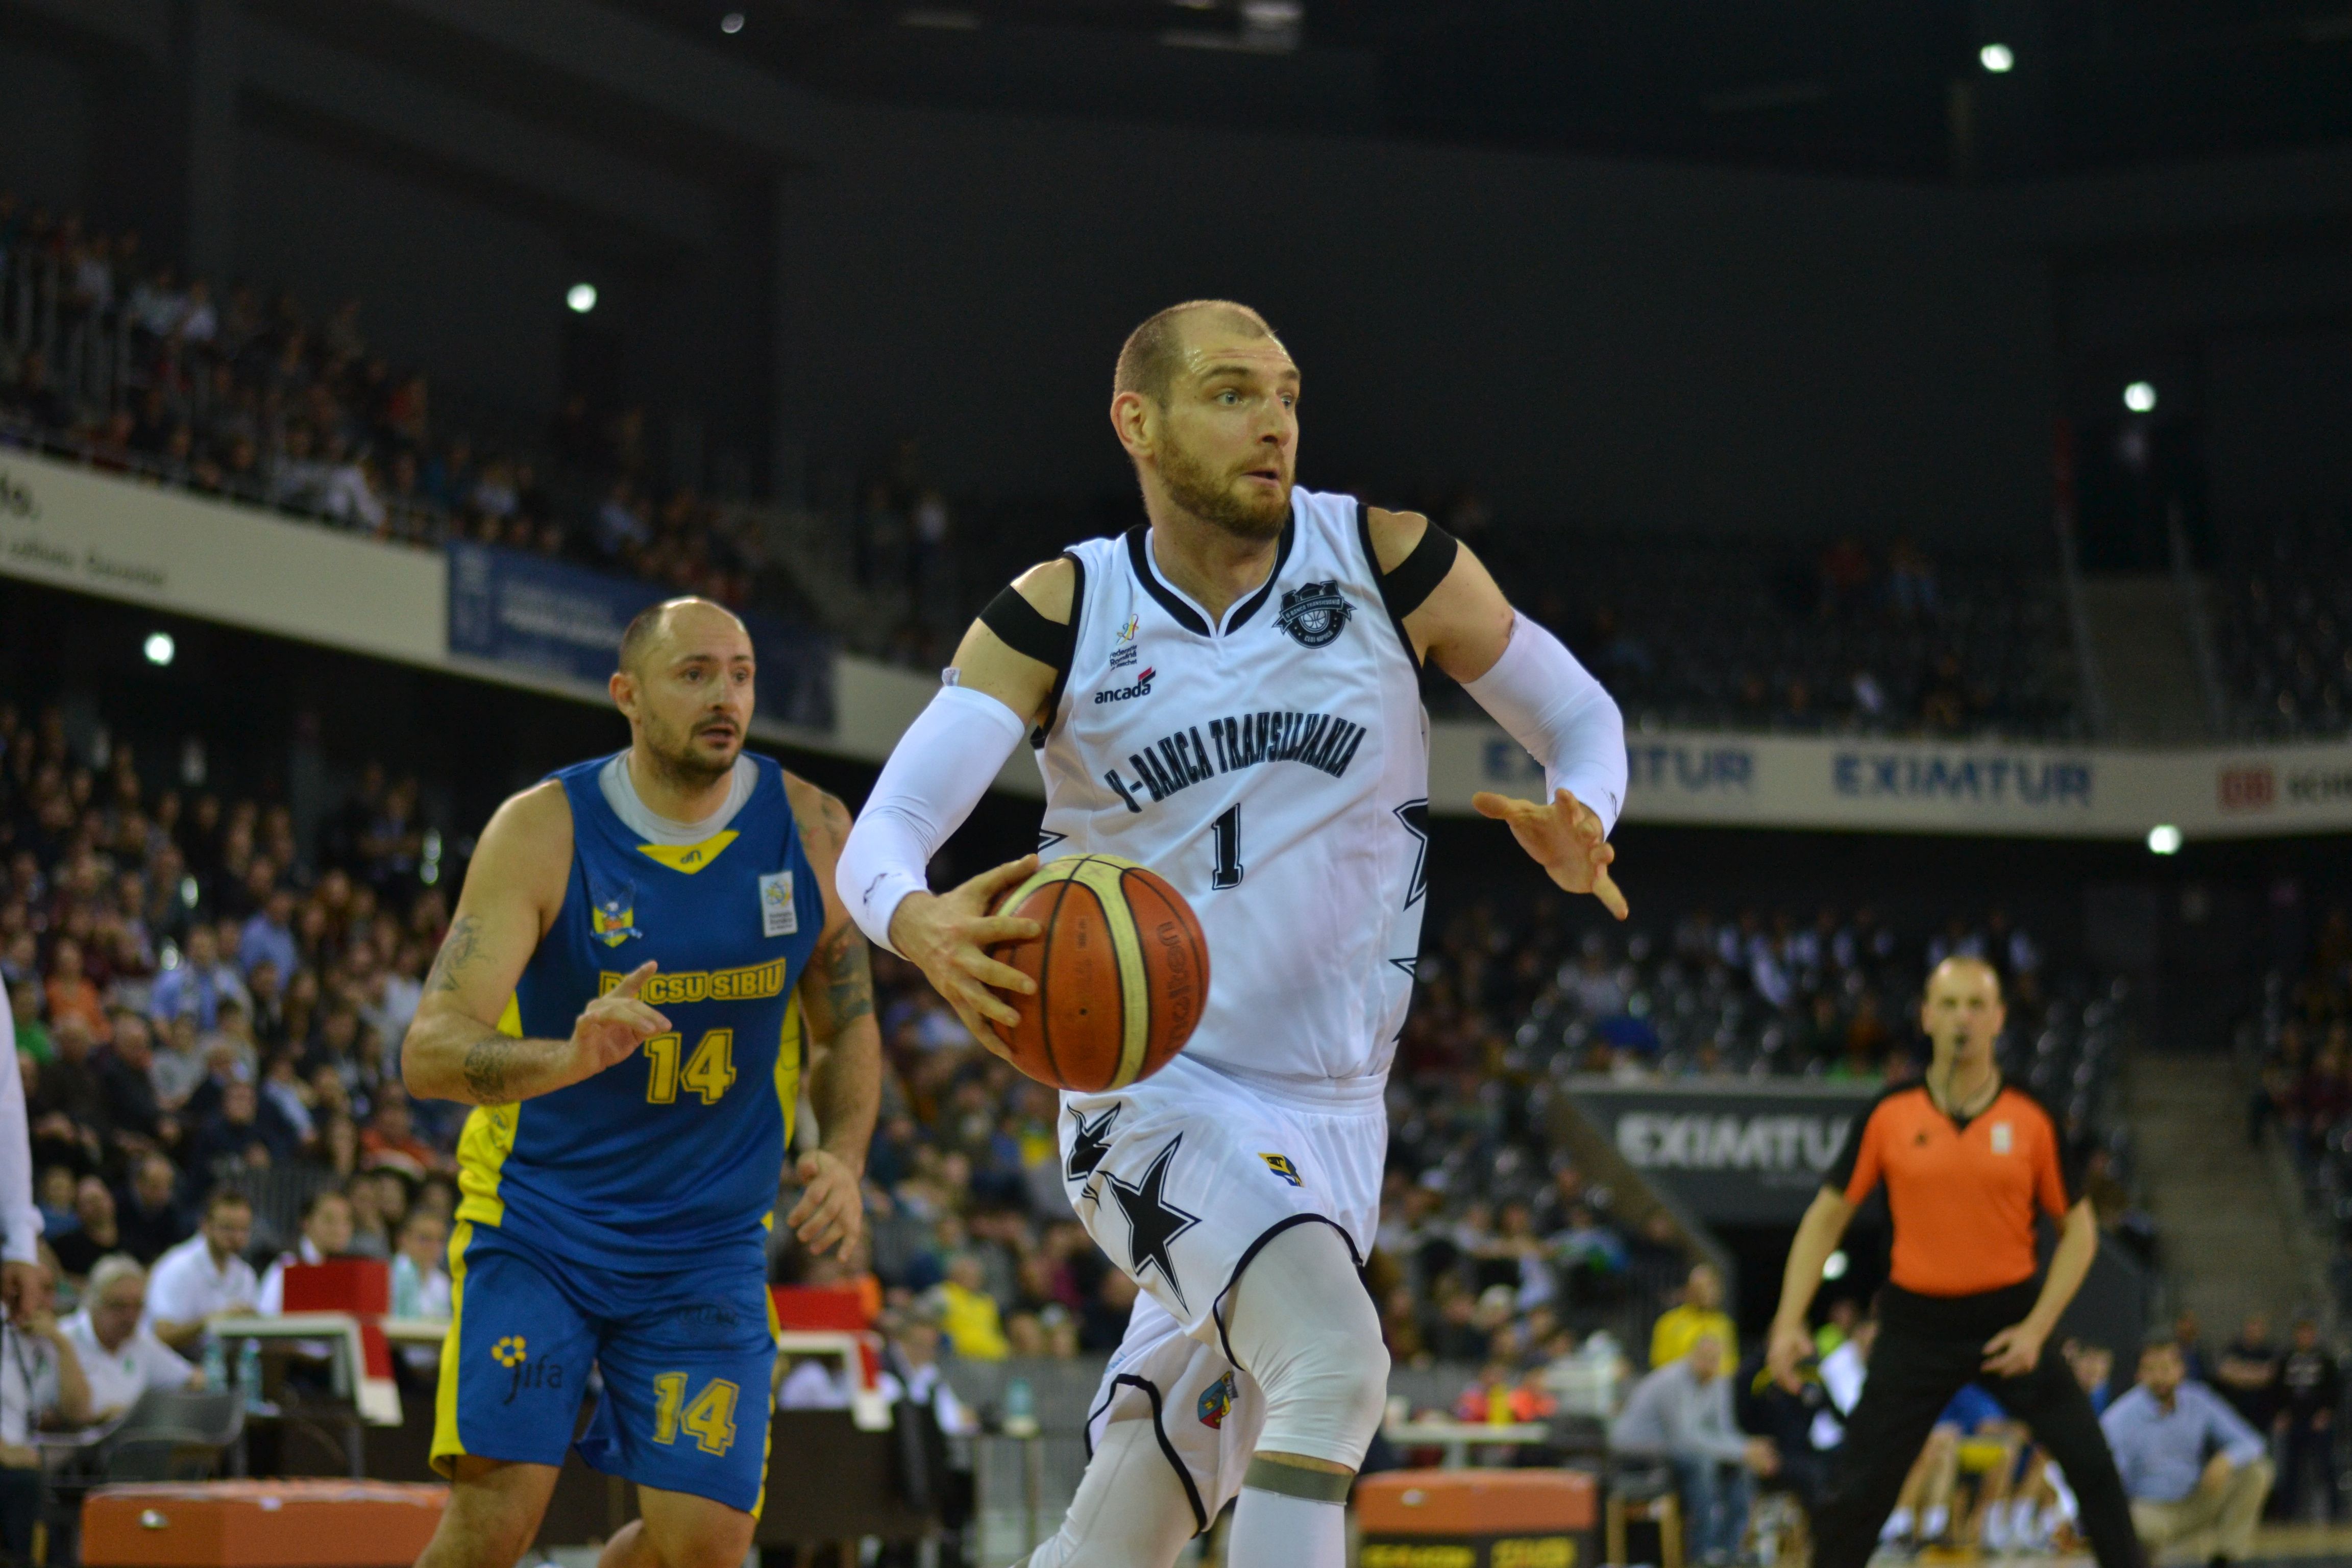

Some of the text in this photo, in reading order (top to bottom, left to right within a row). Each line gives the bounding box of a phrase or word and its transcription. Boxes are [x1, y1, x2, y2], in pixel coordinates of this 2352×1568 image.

[1094, 680, 1151, 704] ancada
[1209, 712, 1366, 778] TRANSILVANIA
[1832, 753, 2094, 808] EXIMTUR
[1211, 803, 1243, 891] 1
[644, 972, 709, 1005] CSU
[709, 957, 786, 1000] SIBIU
[644, 1028, 736, 1105] 14
[1616, 1112, 1852, 1170] EXIMTU
[653, 1371, 740, 1457] 14
